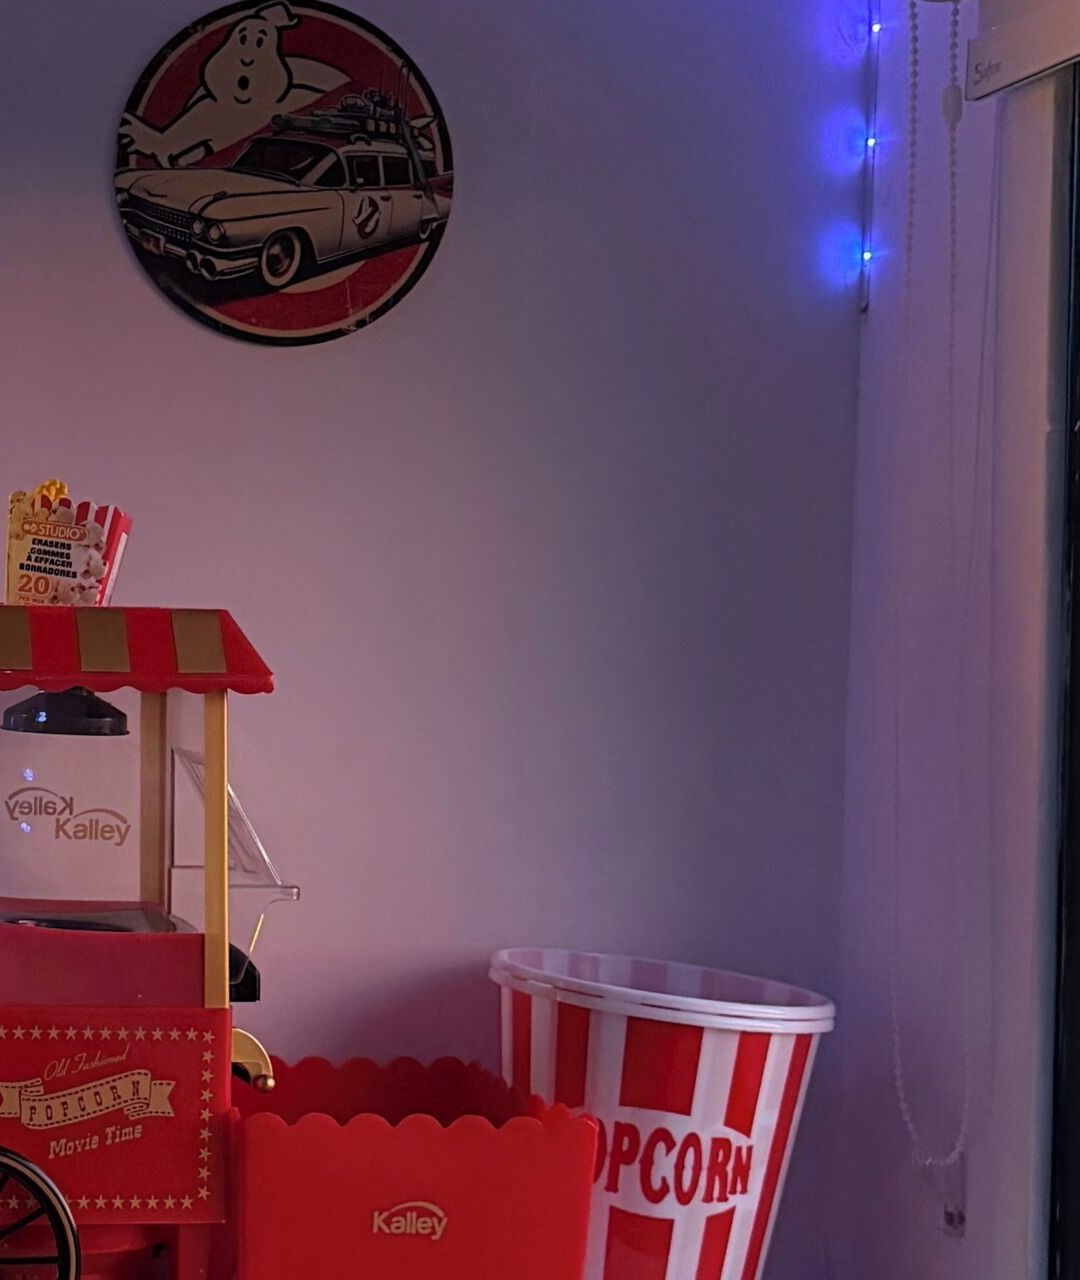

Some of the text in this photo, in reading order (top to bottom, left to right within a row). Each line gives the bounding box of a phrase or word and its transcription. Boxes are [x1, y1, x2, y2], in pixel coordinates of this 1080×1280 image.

[31, 538, 72, 551] ERASERS
[37, 523, 80, 540] STUDIO
[29, 547, 71, 560] GOMMES
[33, 555, 73, 569] EFFACER
[17, 573, 51, 595] 20
[18, 562, 78, 579] BORRADORES
[54, 815, 132, 847] Kalley
[43, 1042, 131, 1081] Old Fashioned
[28, 1079, 141, 1122] POPCORN
[48, 1123, 143, 1160] Movie Time
[593, 1117, 754, 1206] PCORN
[372, 1209, 448, 1241] Kalley
